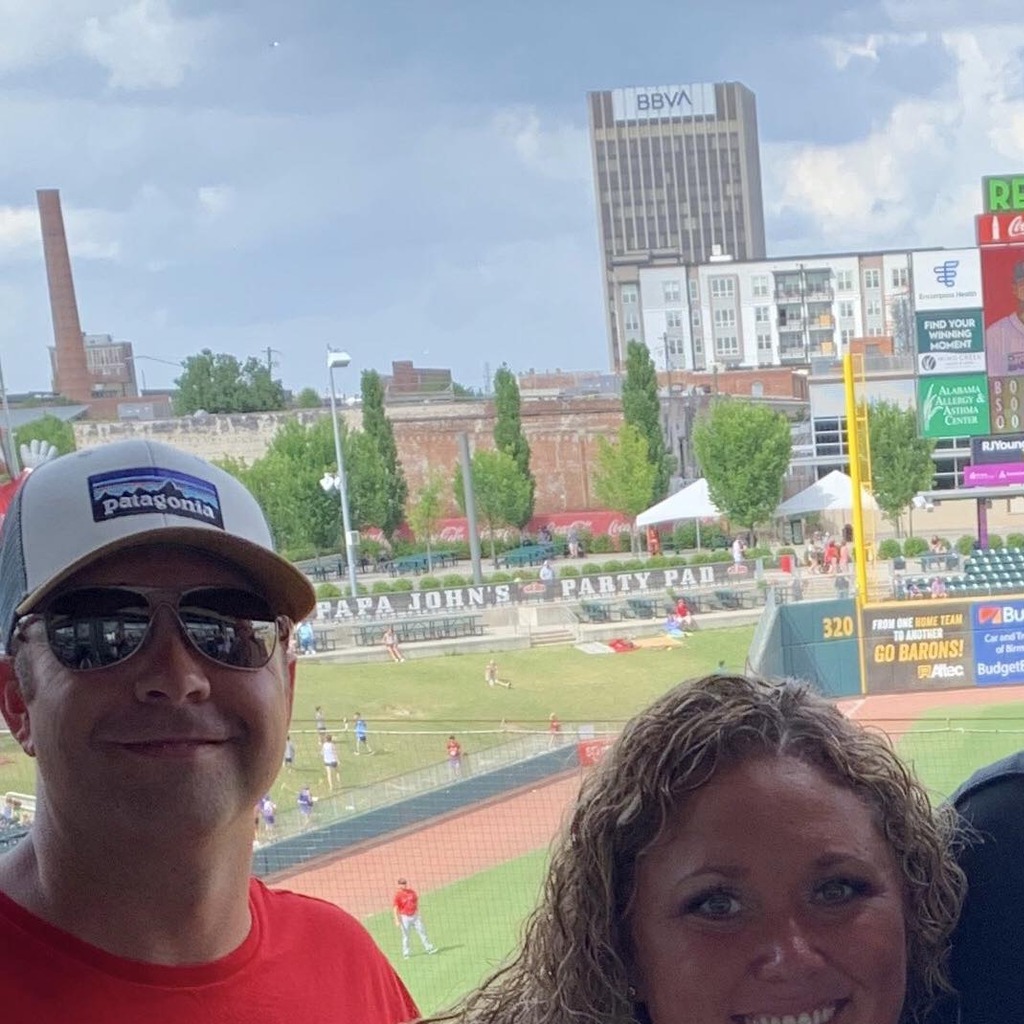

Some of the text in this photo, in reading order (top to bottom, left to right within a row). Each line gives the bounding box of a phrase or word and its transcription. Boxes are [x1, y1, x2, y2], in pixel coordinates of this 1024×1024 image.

[637, 89, 692, 111] BBVA
[924, 318, 976, 330] FIND YOUR
[928, 328, 973, 340] WINNING
[930, 339, 973, 351] MOMENT
[939, 385, 982, 396] ALABAMA
[935, 393, 986, 407] ALLERGY &
[942, 405, 979, 416] ASTHMA
[944, 415, 979, 426] CENTER
[102, 493, 215, 519] patagonia
[560, 572, 651, 596] PARTY
[664, 566, 716, 587] PAD
[315, 596, 396, 620] PAPA
[408, 584, 510, 611] JOHN'S
[822, 615, 854, 639] 320
[872, 613, 963, 630] FROM ONE HOME TEAM
[894, 628, 944, 641] TO ANOTHER
[984, 633, 999, 643] Car
[1000, 633, 1016, 641] and
[874, 639, 964, 663] GO BARONS!
[995, 644, 1005, 654] of
[931, 663, 965, 679] Altec
